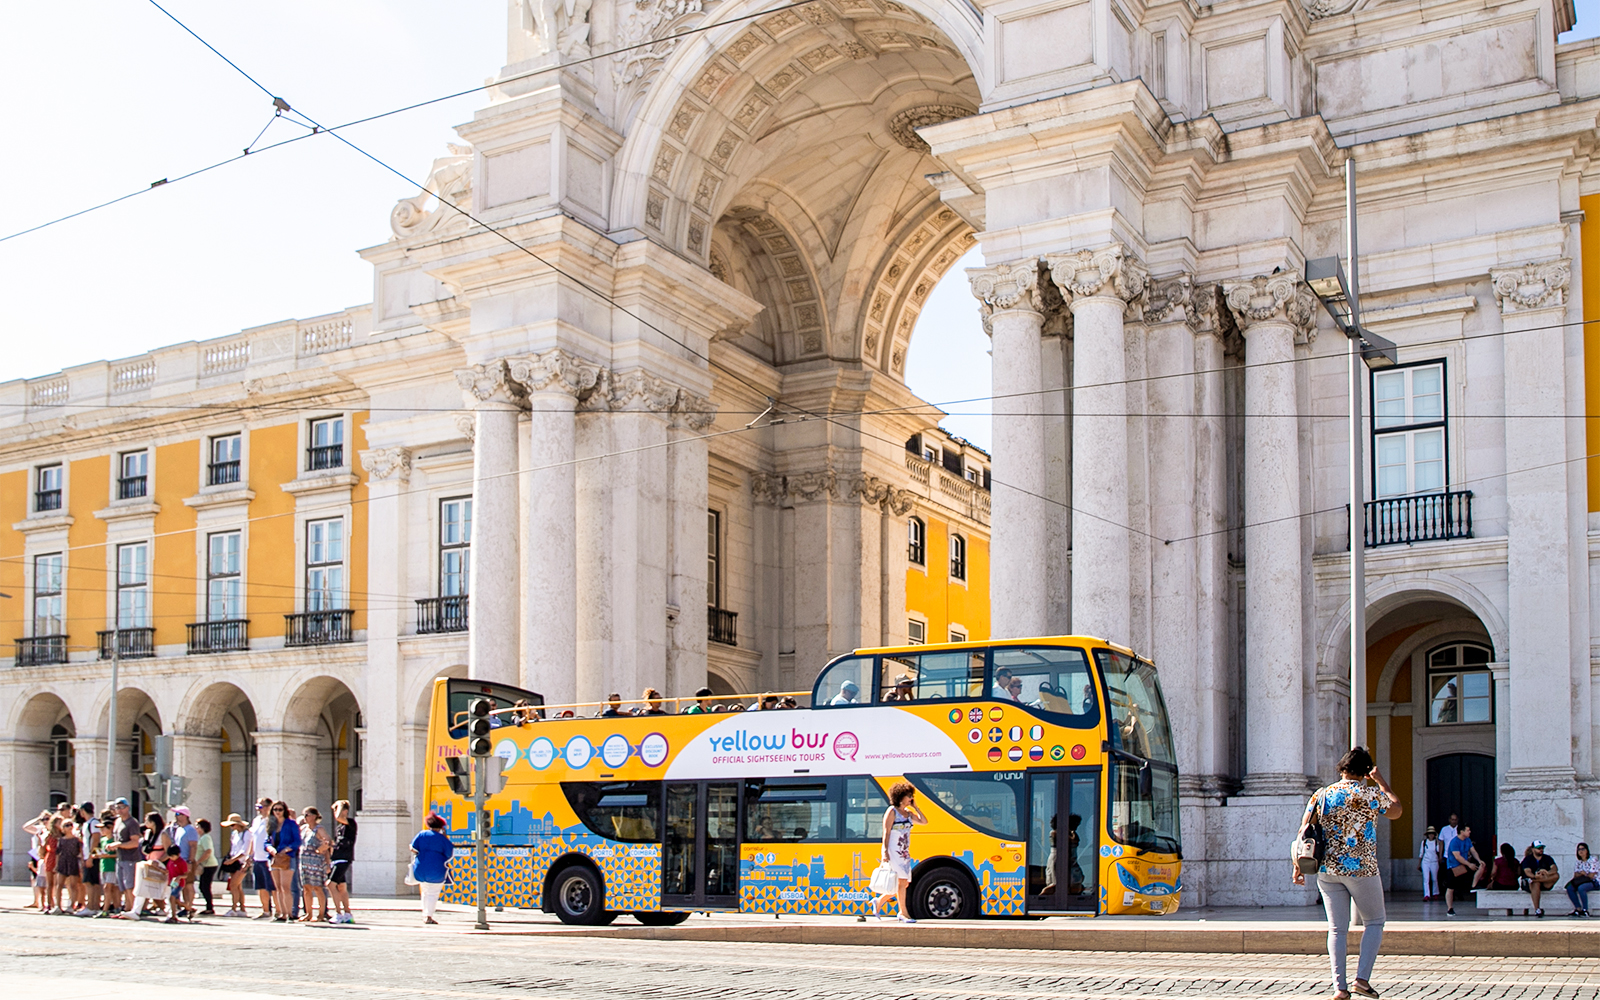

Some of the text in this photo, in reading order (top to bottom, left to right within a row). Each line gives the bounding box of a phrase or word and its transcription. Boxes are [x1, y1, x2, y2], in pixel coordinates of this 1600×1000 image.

[791, 727, 829, 749] bus
[437, 745, 463, 757] This
[865, 751, 942, 760] www.yellowbustours.com
[712, 752, 826, 764] OFFICIAL SIGHTSEEING TOURS
